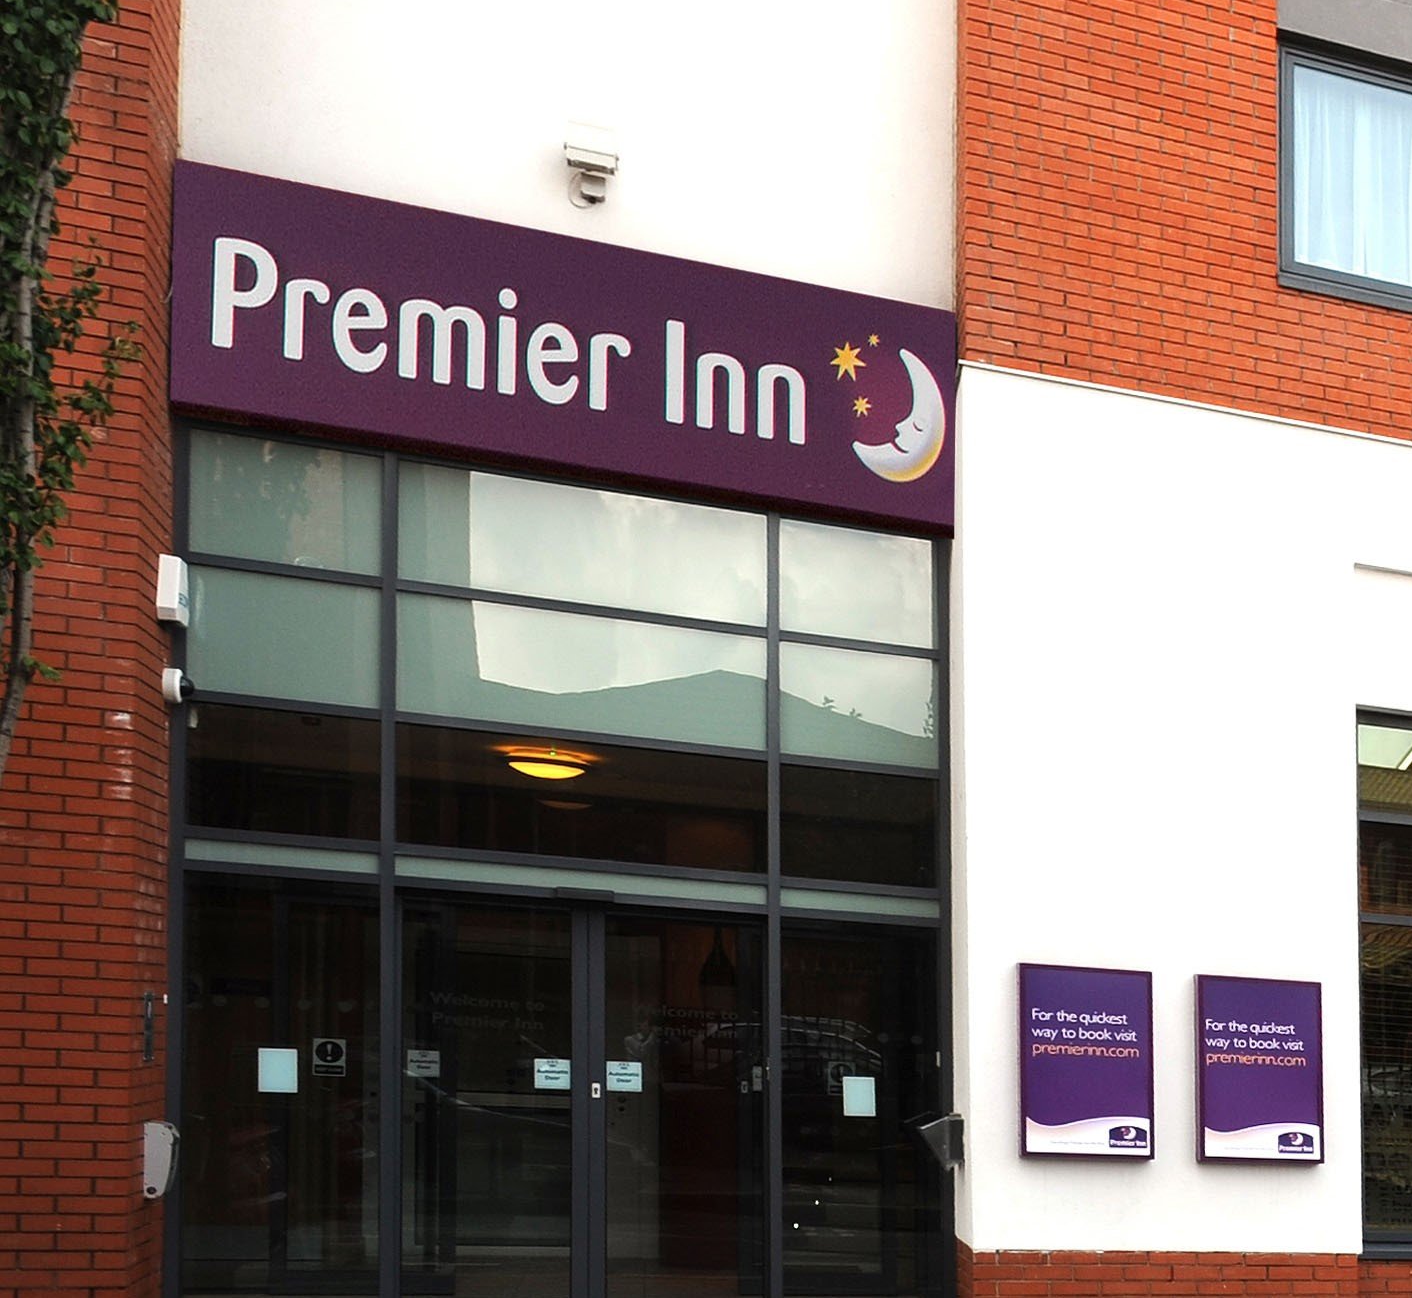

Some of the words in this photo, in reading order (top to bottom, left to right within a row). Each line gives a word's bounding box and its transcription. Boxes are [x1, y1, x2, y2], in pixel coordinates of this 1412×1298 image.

[211, 236, 631, 412] Premier
[665, 318, 807, 446] Inn
[428, 991, 519, 1011] Welcome
[525, 996, 546, 1012] to
[430, 1011, 510, 1031] Premier
[513, 1017, 546, 1032] Inn
[1031, 1007, 1054, 1021] For
[1056, 1009, 1078, 1022] the
[1079, 1010, 1128, 1026] quickest
[1031, 1028, 1058, 1041] way
[1061, 1027, 1076, 1039] to
[1078, 1027, 1112, 1040] book
[1114, 1028, 1138, 1042] visit
[1205, 1018, 1226, 1031] For
[1228, 1020, 1248, 1033] the
[1249, 1021, 1296, 1036] quickest
[1032, 1042, 1140, 1058] premierinn.com
[1205, 1037, 1230, 1050] way
[1233, 1037, 1247, 1048] to
[1249, 1036, 1280, 1049] book
[1282, 1038, 1305, 1051] visit
[1206, 1051, 1306, 1067] premierinn.com
